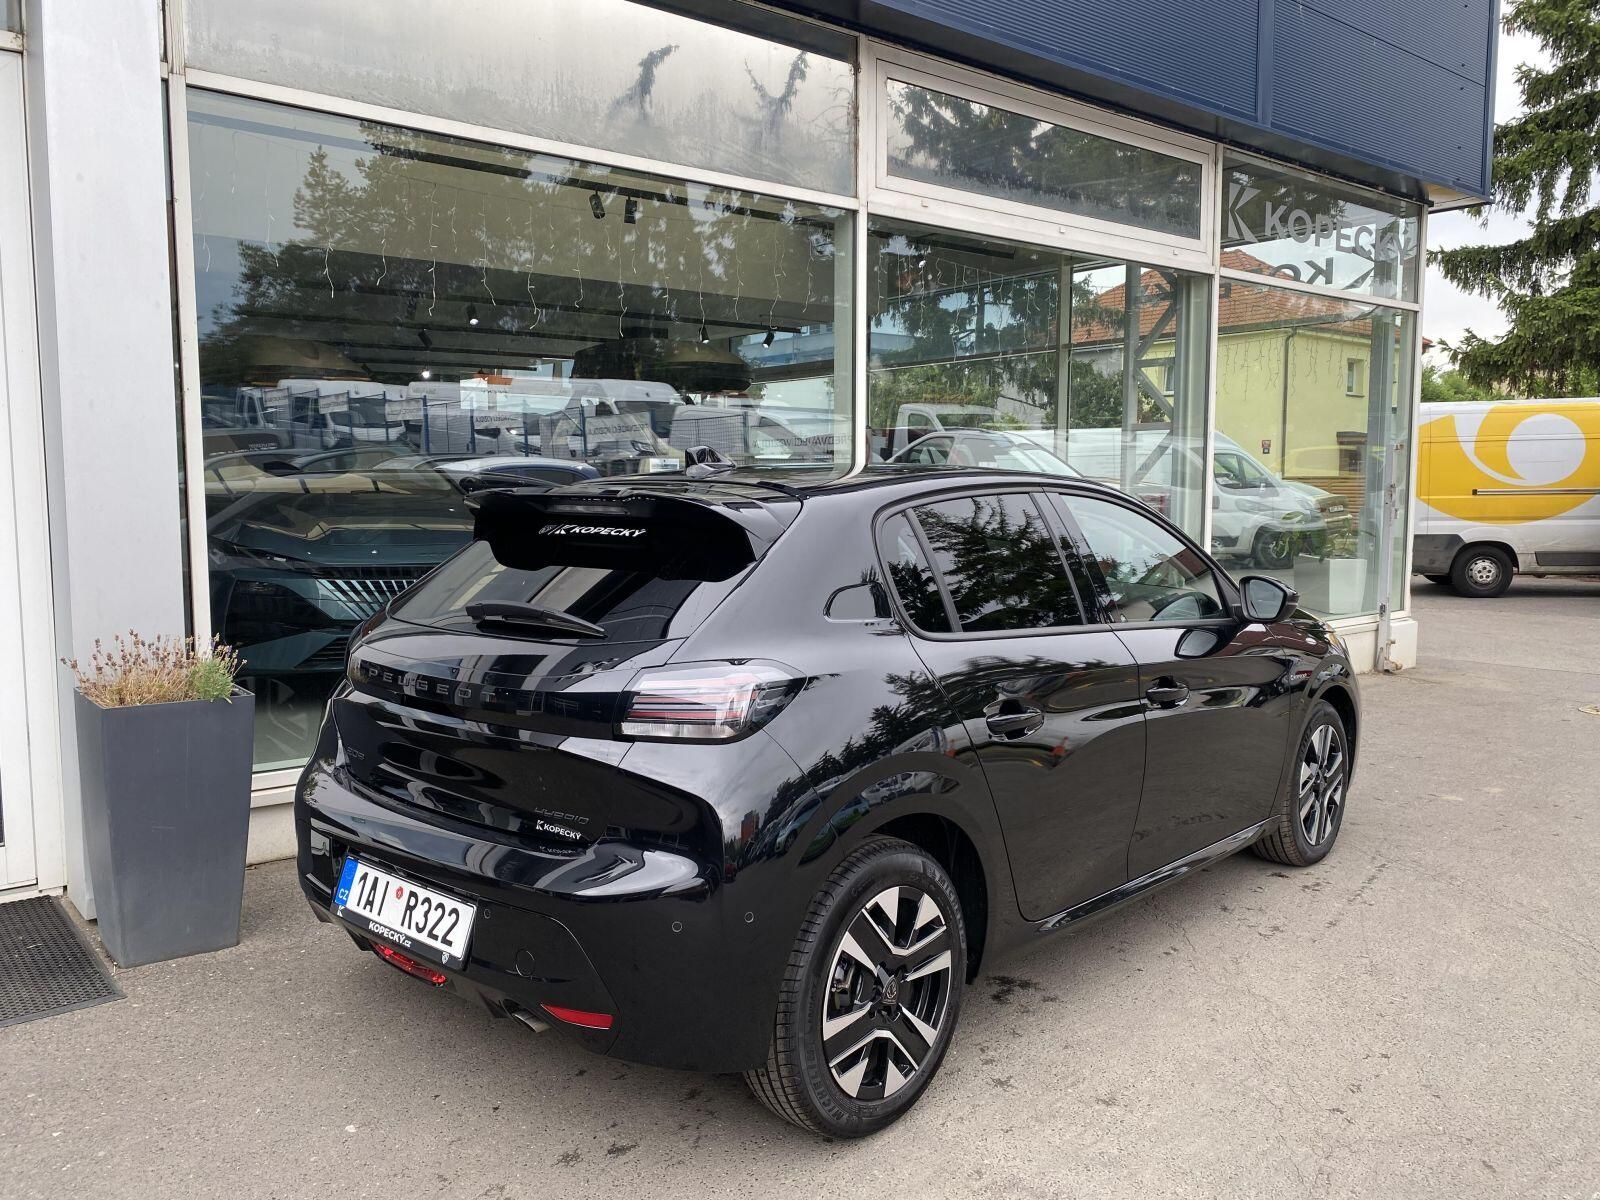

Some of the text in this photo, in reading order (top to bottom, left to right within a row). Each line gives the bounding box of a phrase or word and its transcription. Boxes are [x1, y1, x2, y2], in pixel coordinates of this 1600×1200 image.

[368, 667, 497, 704] PEUGEOT
[338, 888, 349, 901] CZ
[356, 871, 461, 948] 1AI R322
